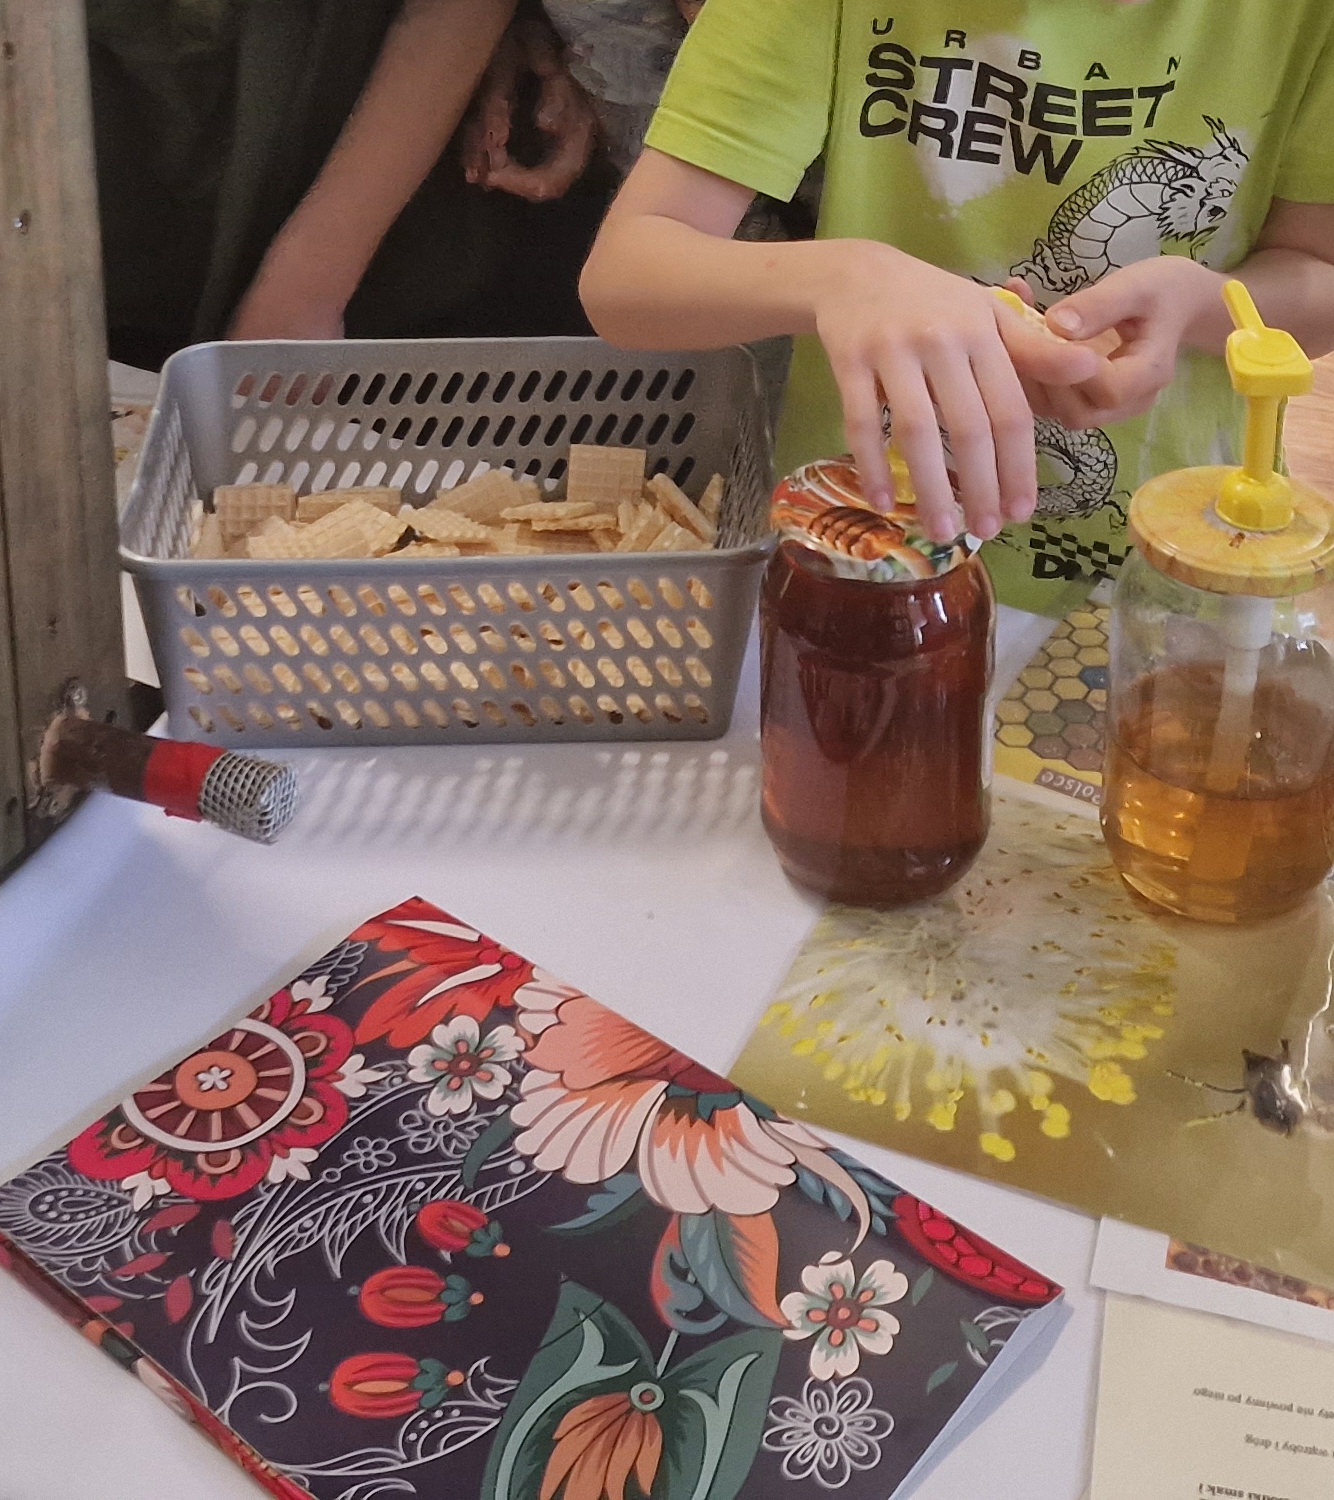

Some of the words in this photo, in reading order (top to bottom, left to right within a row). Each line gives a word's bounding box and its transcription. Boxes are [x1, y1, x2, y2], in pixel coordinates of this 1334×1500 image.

[865, 42, 1176, 137] STREET
[871, 17, 1181, 80] URBAN
[860, 88, 1083, 185] CREW
